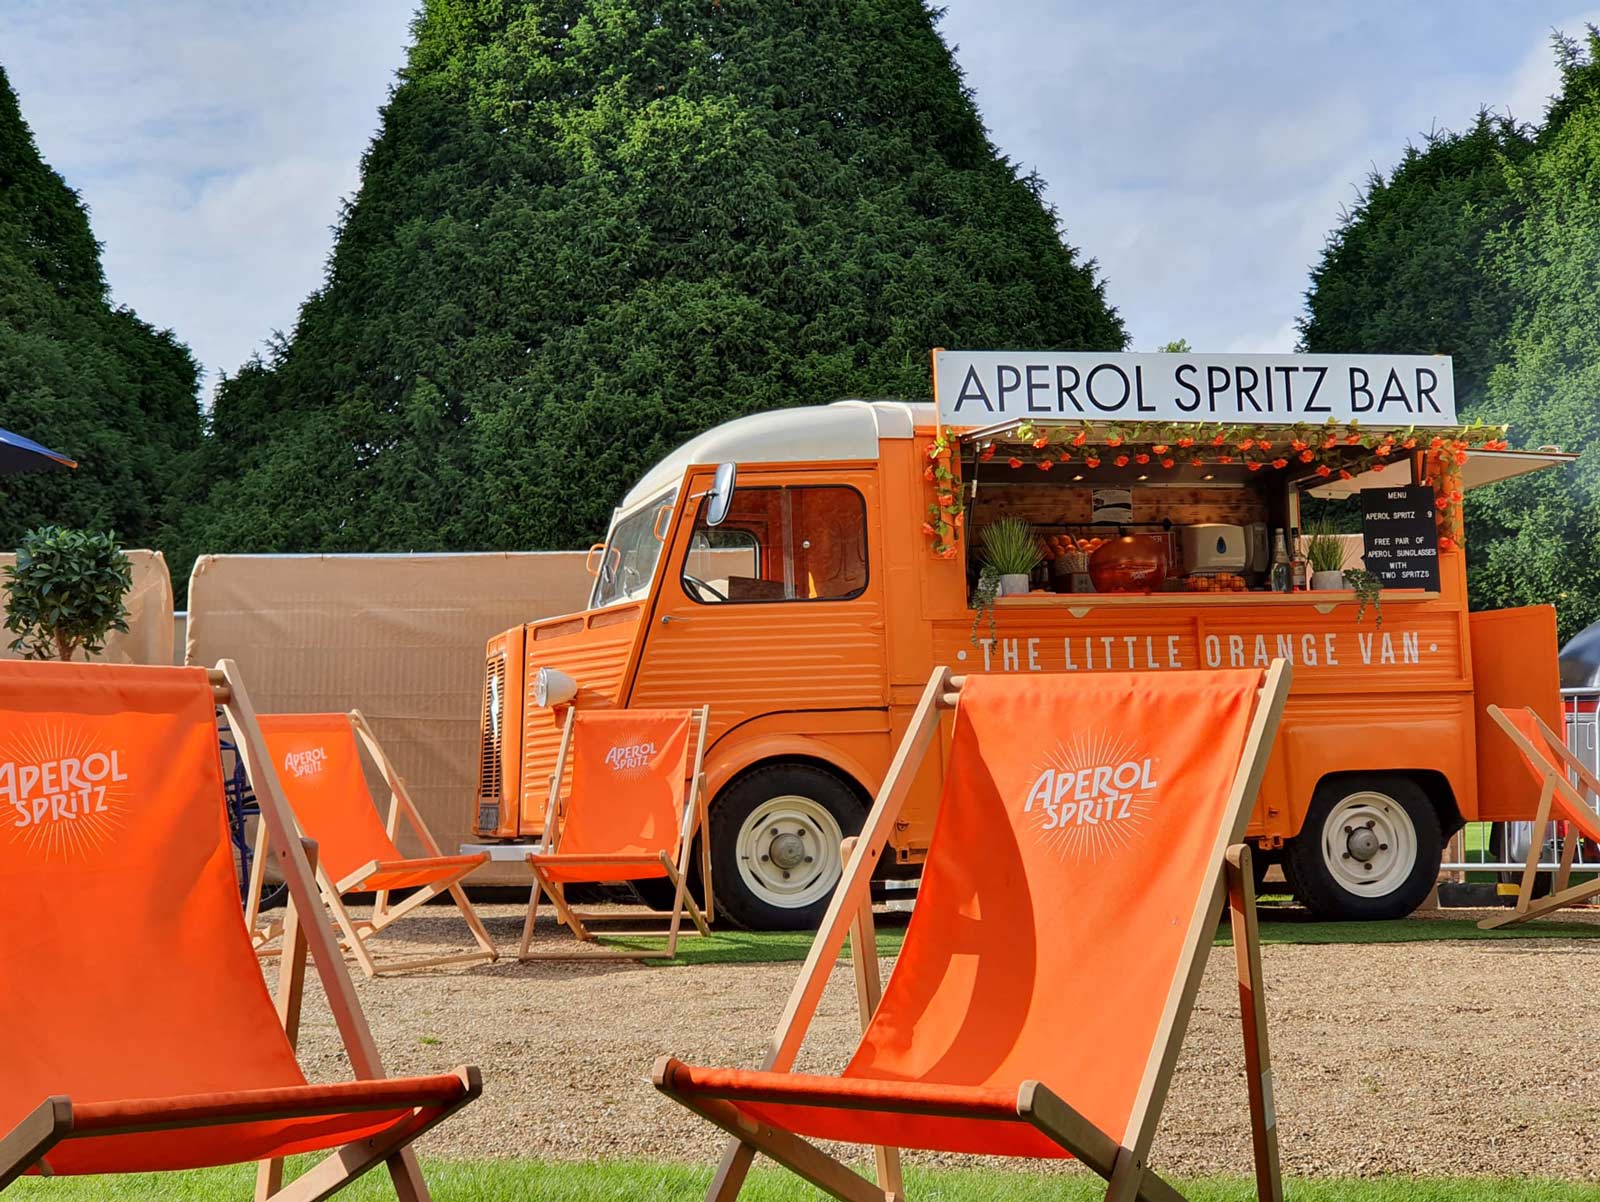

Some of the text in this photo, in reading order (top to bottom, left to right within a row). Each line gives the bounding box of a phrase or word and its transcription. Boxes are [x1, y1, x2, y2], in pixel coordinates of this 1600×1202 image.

[954, 363, 1443, 414] APEROL SPRITZ BAR
[1387, 491, 1408, 500] MENU
[1365, 512, 1391, 521] APEROL
[1393, 511, 1416, 520] SPRITZ
[1374, 536, 1425, 546] FREE PAIR OF
[1367, 548, 1437, 559] APEROL SUNGLASSES
[1389, 561, 1408, 570] WITH
[1381, 570, 1430, 580] TWO SPRITZS
[979, 631, 1420, 672] THE LITTLE ORANGE VAN
[284, 746, 329, 772] APEROL
[605, 742, 657, 765] APEROL
[1023, 758, 1158, 813] APEROL
